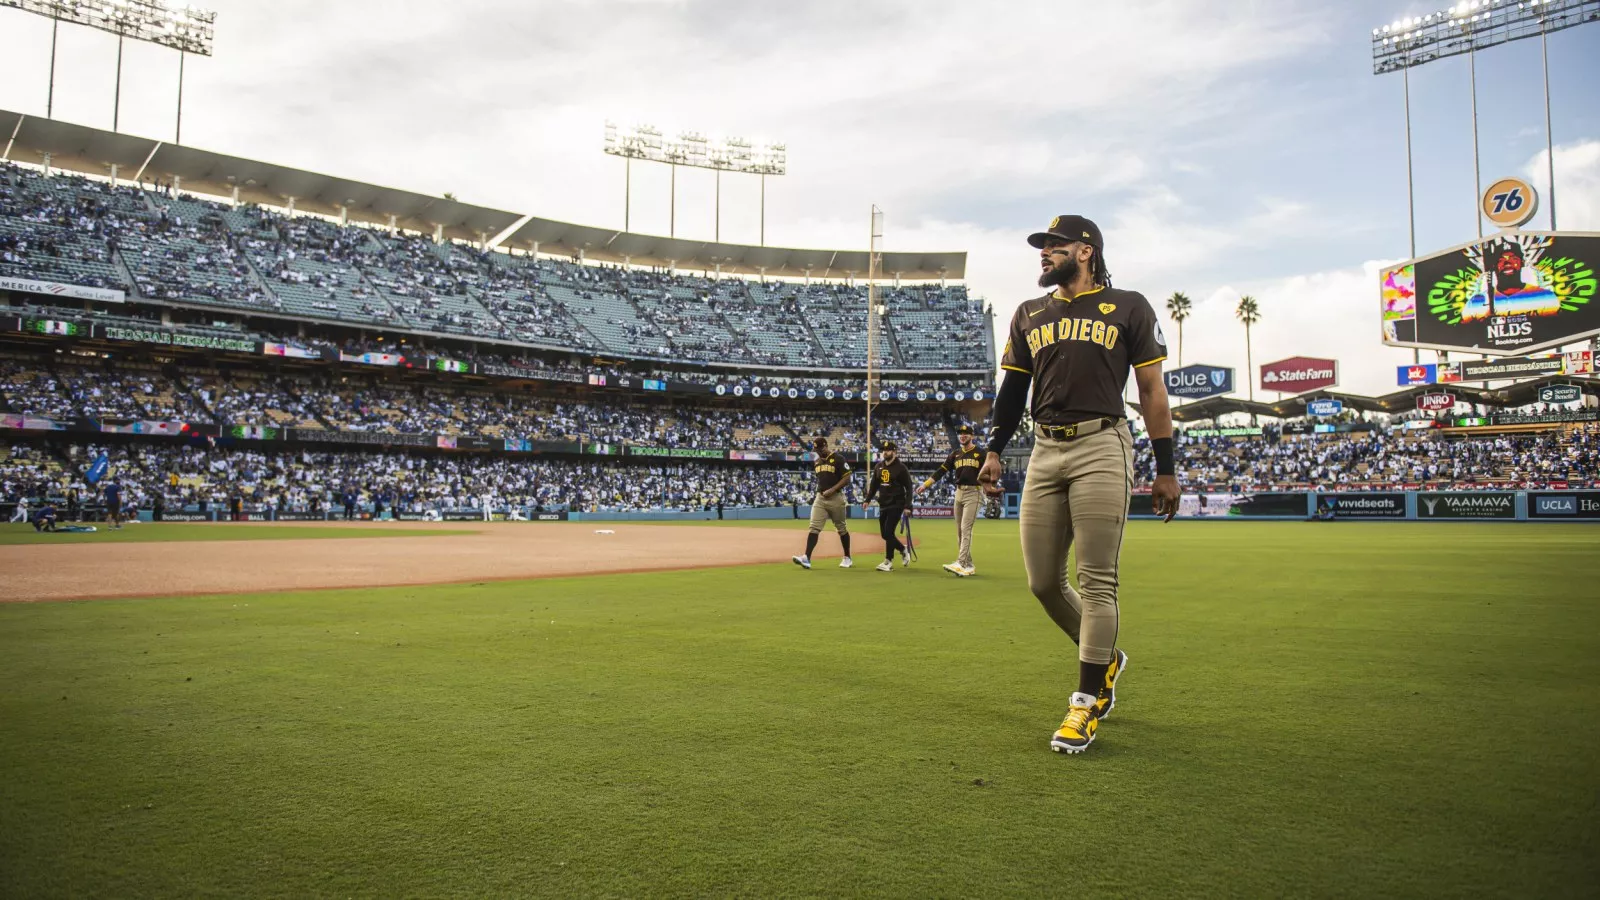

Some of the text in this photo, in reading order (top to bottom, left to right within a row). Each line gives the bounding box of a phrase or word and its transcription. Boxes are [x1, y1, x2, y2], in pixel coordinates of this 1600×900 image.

[1491, 188, 1524, 215] 76
[1, 280, 43, 292] MERICA
[1487, 321, 1533, 339] NLDS
[1026, 317, 1119, 359] SAN DIEGO
[1494, 337, 1533, 346] Booking.com
[1168, 371, 1207, 388] blue
[1174, 385, 1212, 395] california
[1554, 387, 1577, 396] Security
[1422, 395, 1450, 408] JINRO
[1065, 428, 1074, 437] 23
[1338, 497, 1395, 508] vividseats
[1541, 500, 1572, 510] UCLA
[162, 513, 206, 522] Booking.com
